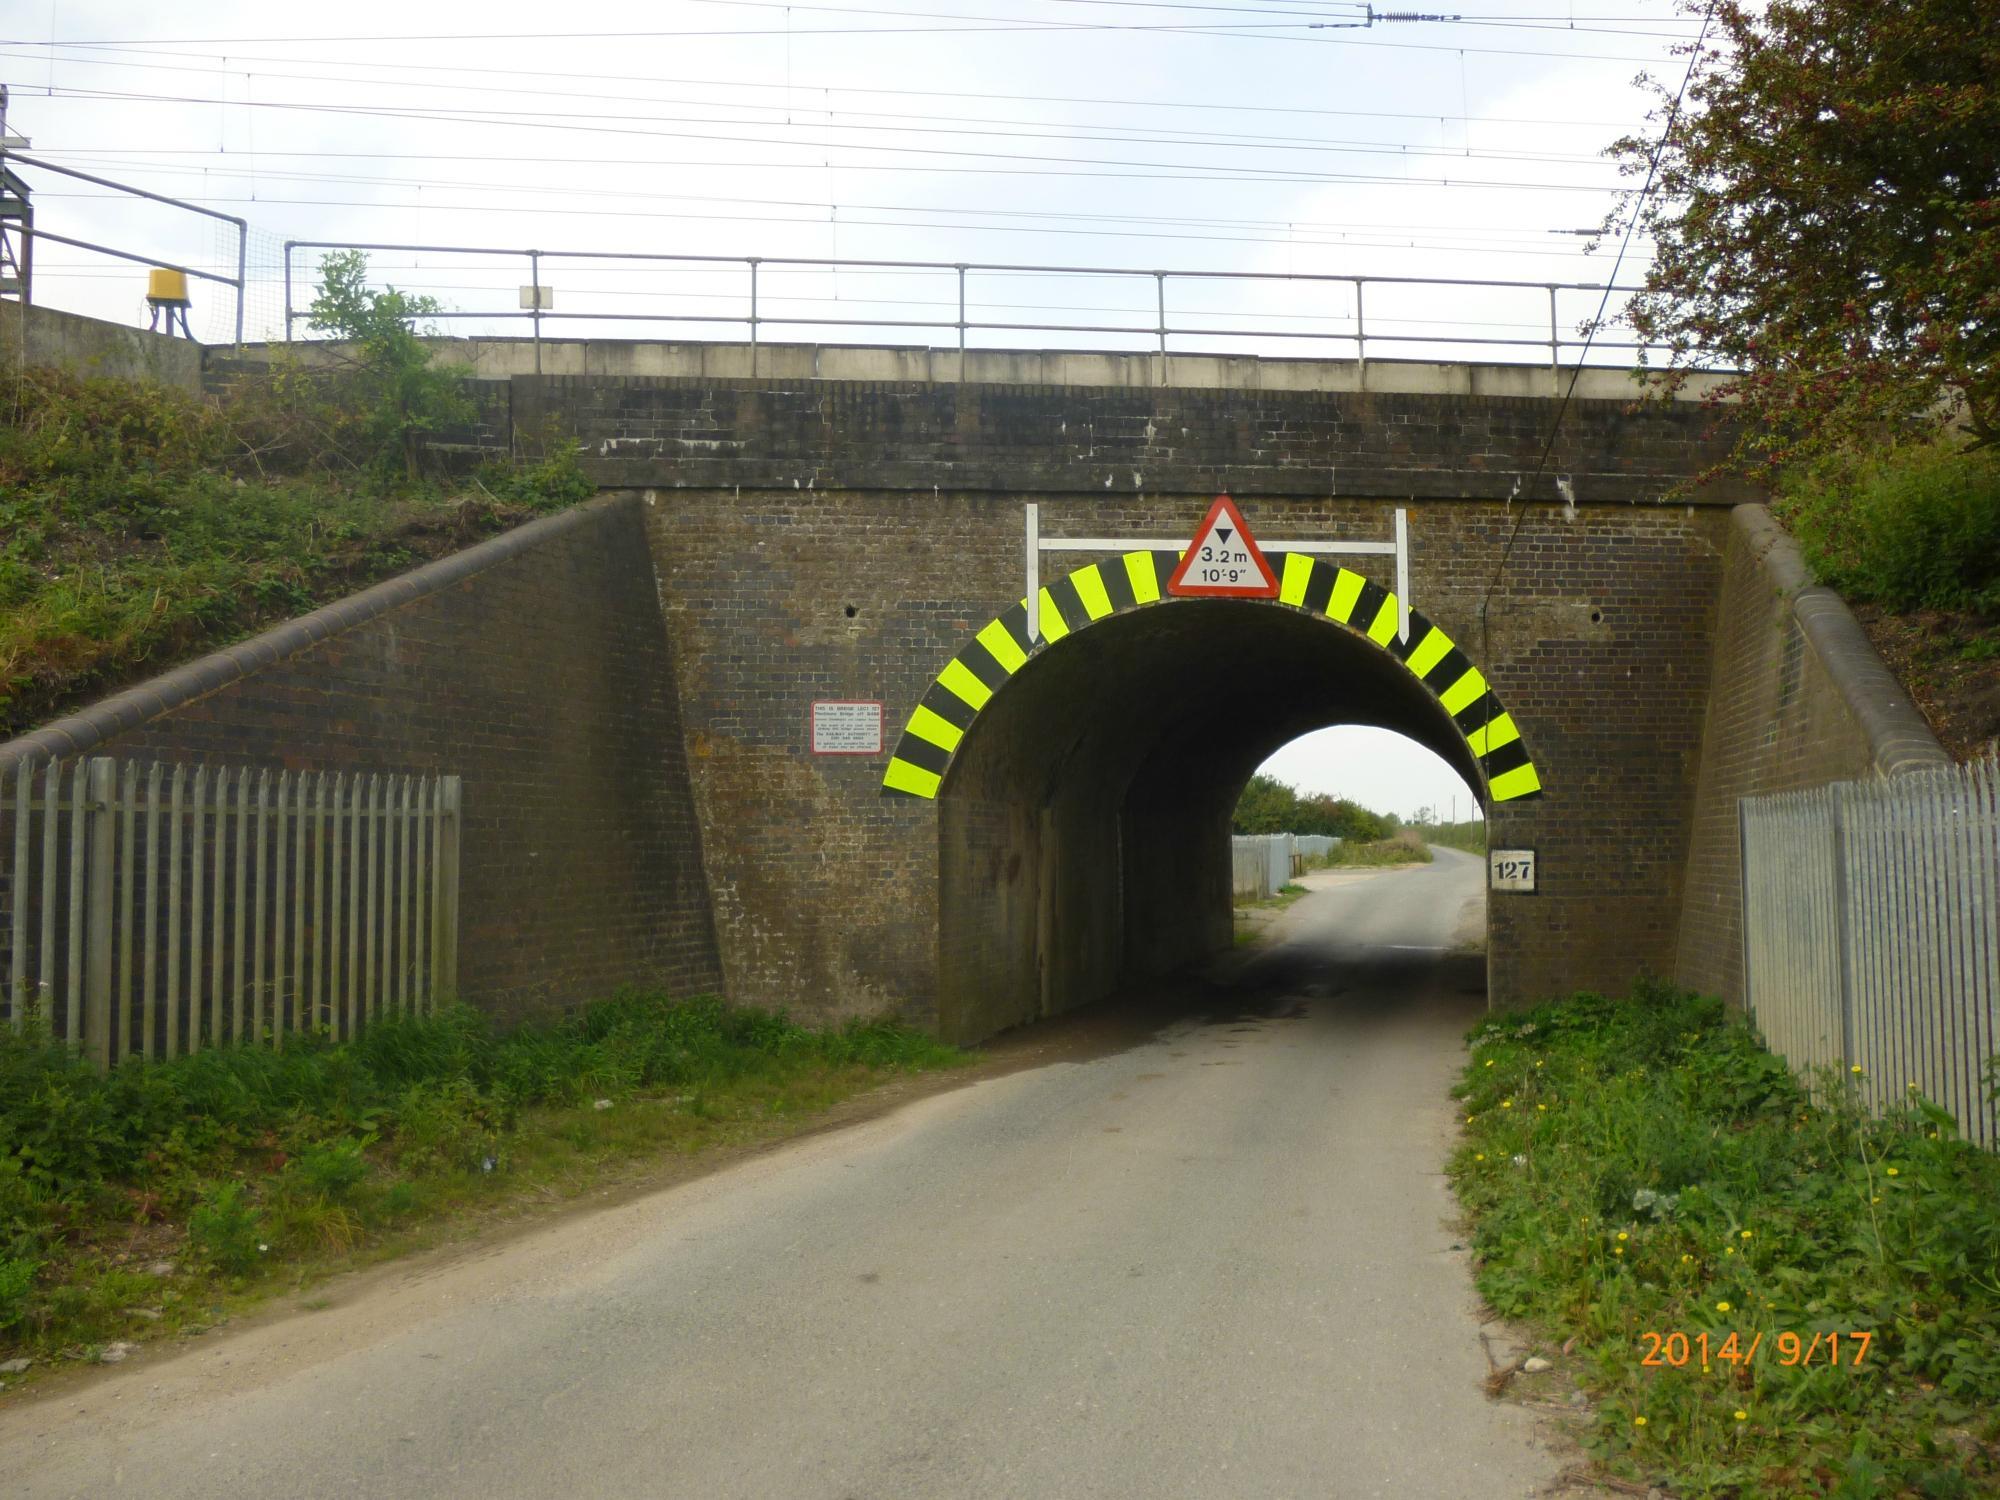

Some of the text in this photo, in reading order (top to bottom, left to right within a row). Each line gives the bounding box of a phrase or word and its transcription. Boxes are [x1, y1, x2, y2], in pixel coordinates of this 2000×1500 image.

[1201, 546, 1248, 563] 3.2 m
[1494, 861, 1531, 880] 127
